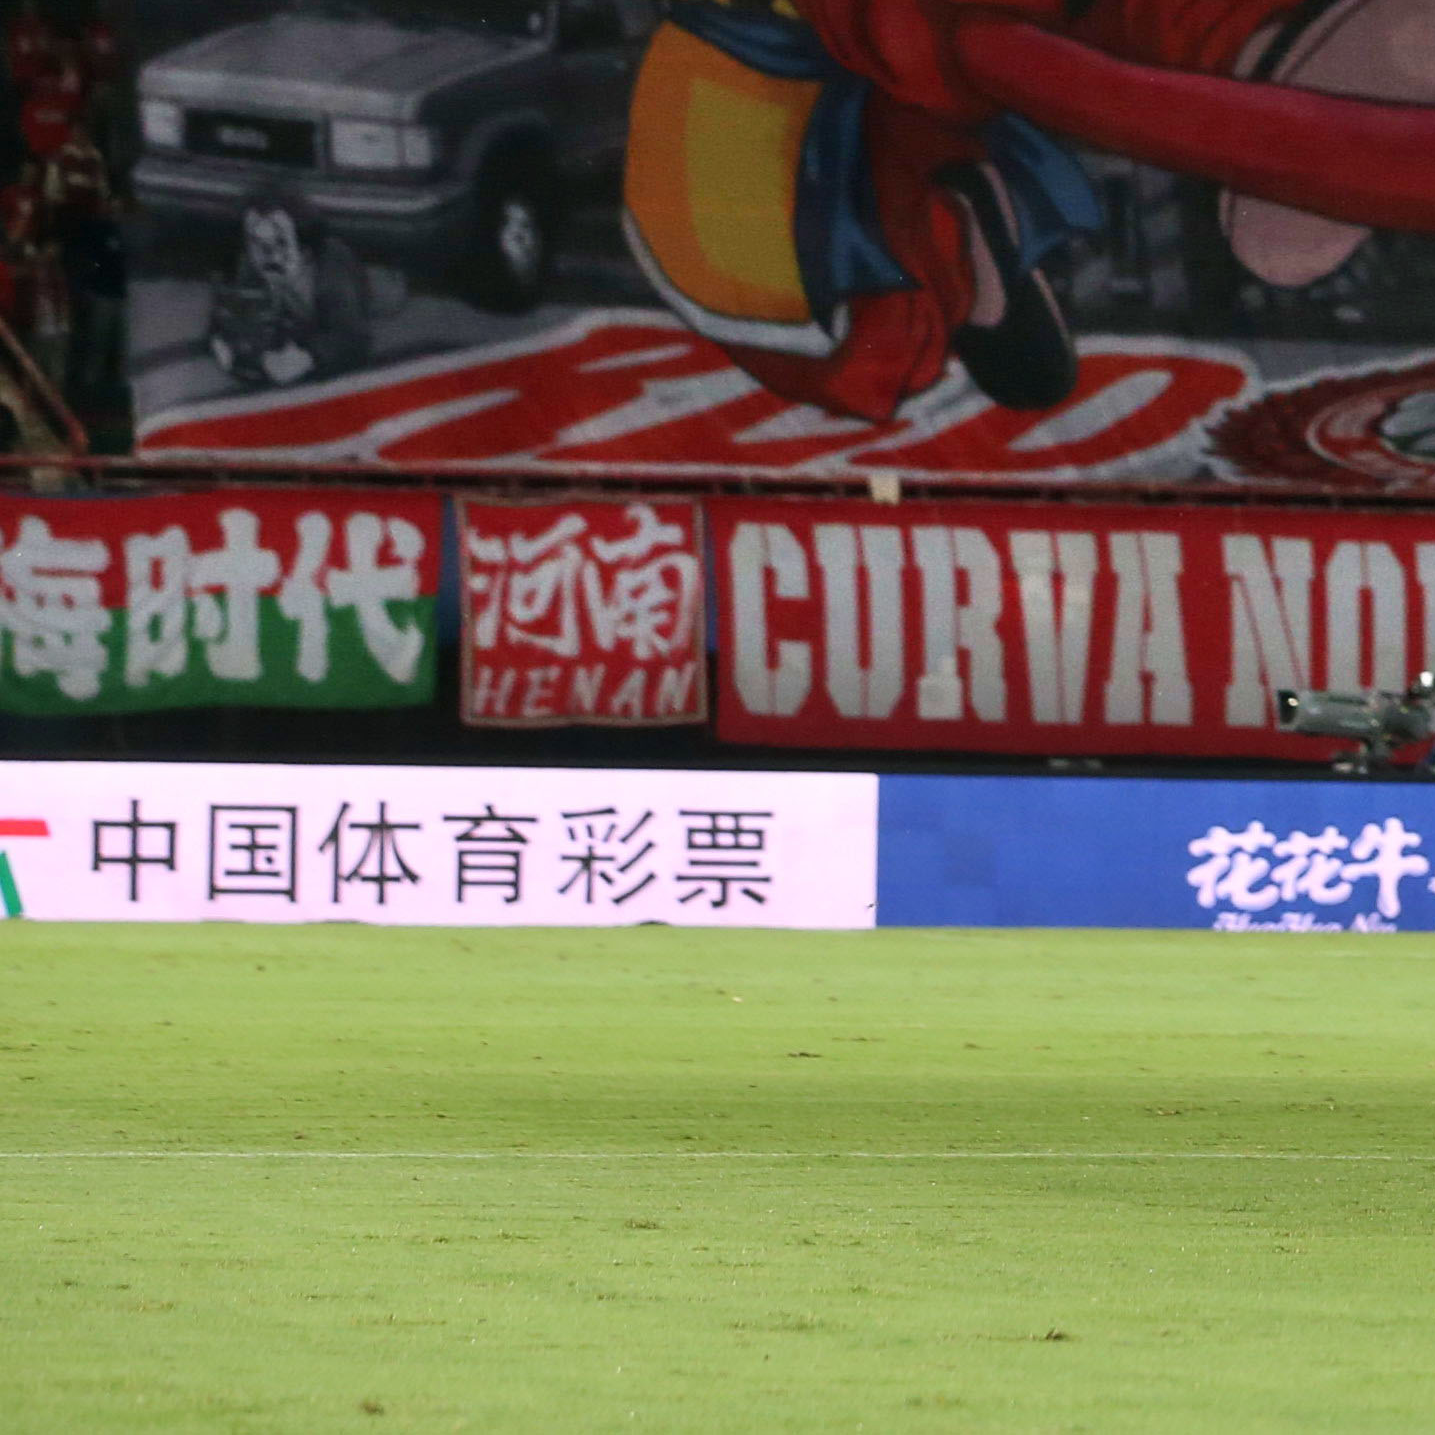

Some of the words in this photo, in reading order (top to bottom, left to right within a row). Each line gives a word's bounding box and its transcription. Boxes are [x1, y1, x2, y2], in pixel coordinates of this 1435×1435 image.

[467, 501, 698, 658] 河南
[728, 522, 1195, 728] CURVA
[471, 662, 698, 718] HENAN
[91, 798, 775, 909] 中国体育彩票
[1186, 817, 1430, 919] 花花牛
